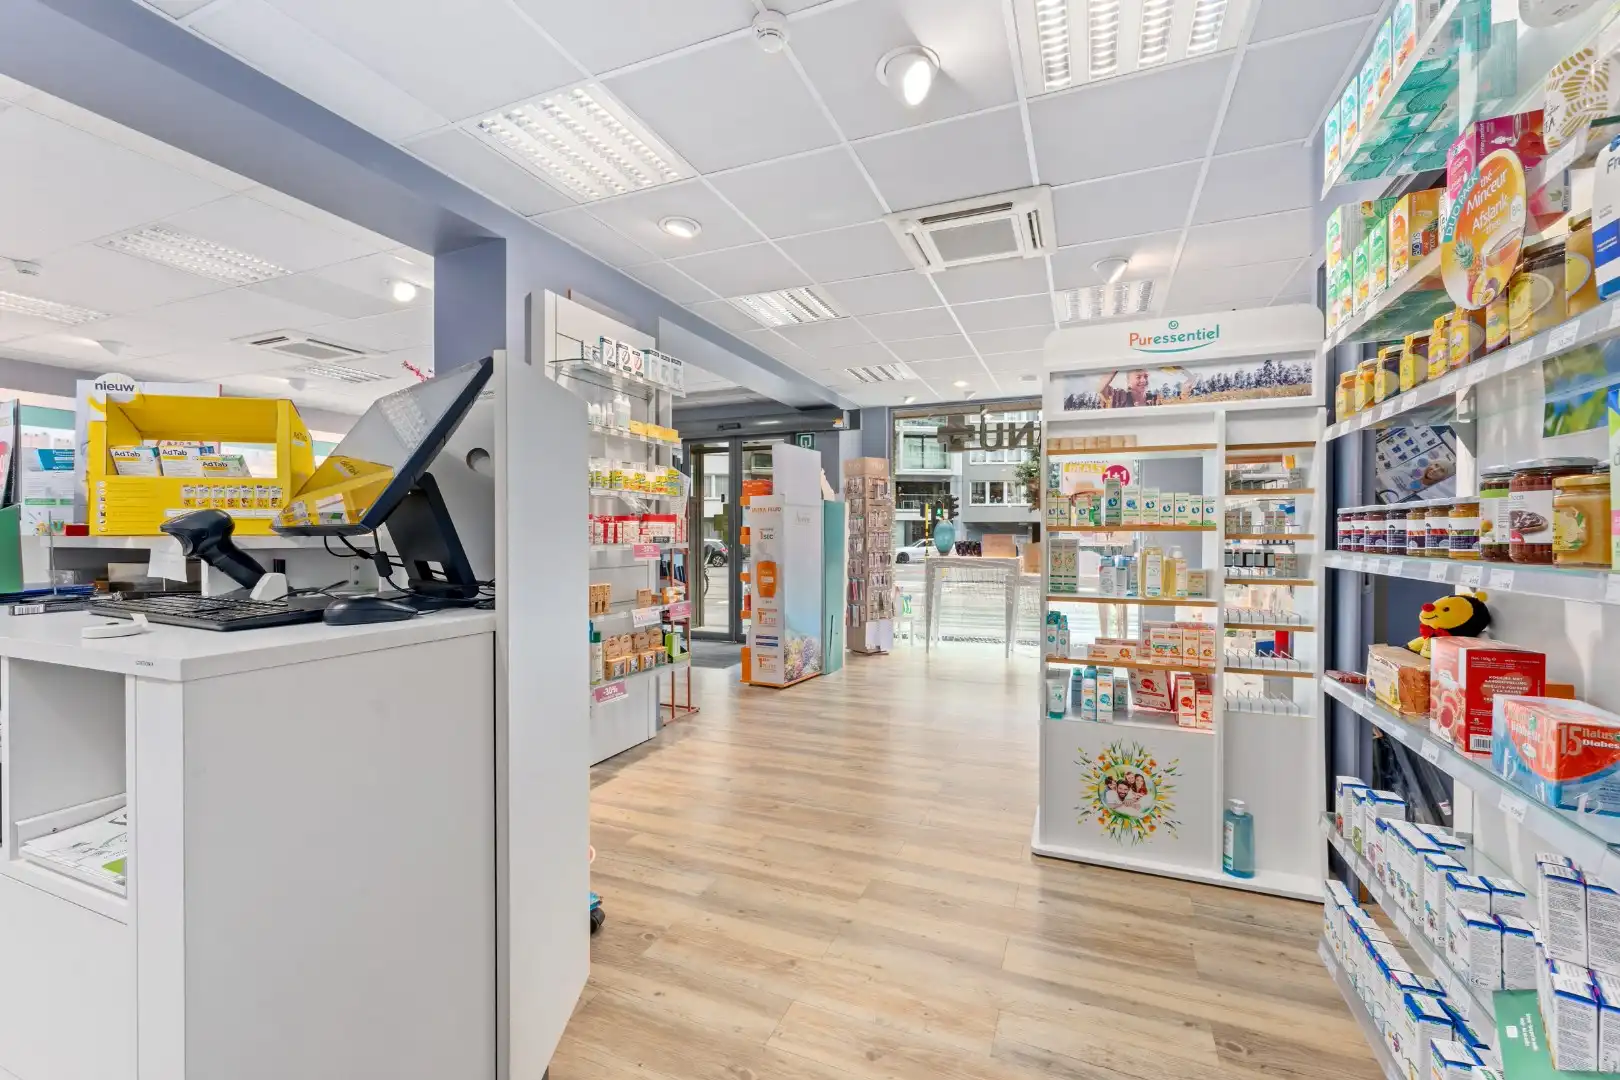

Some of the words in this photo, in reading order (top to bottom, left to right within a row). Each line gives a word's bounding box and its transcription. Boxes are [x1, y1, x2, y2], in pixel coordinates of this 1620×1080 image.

[1445, 205, 1461, 236] DUO
[1460, 172, 1478, 205] PACK
[1467, 168, 1508, 216] Minceur
[1472, 192, 1509, 235] Afslank
[1129, 324, 1220, 346] Puressentiel
[94, 381, 135, 392] nieuw
[1558, 724, 1582, 757] 15
